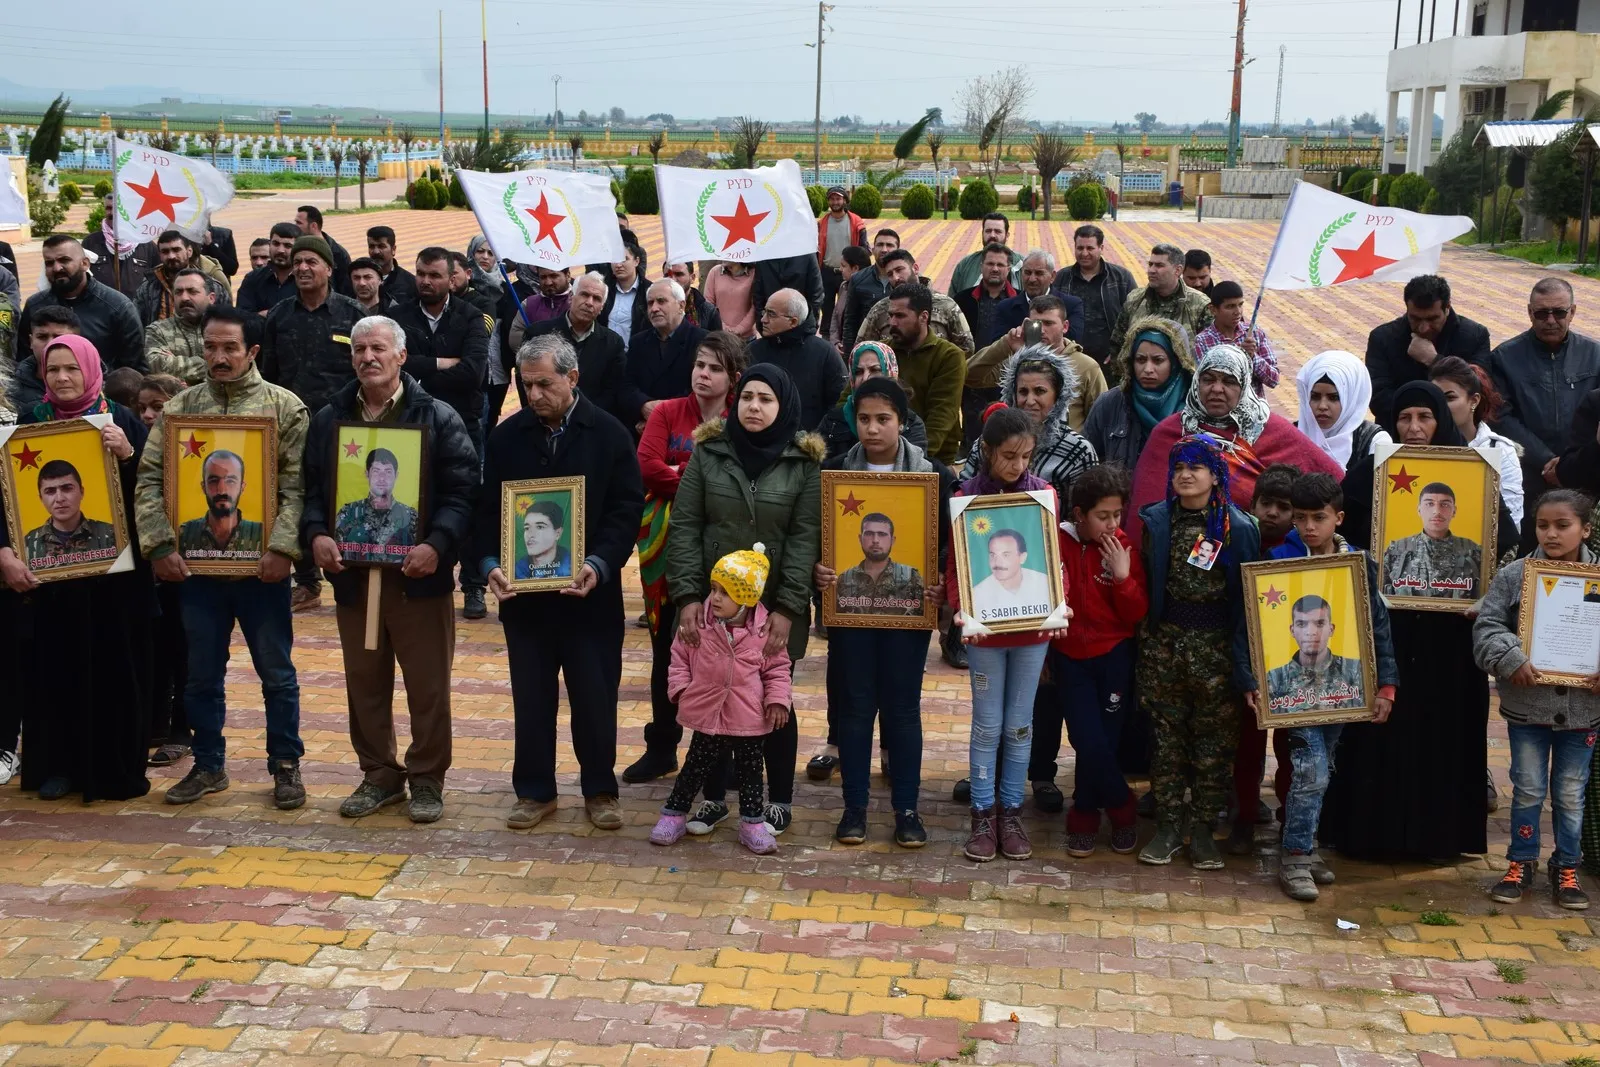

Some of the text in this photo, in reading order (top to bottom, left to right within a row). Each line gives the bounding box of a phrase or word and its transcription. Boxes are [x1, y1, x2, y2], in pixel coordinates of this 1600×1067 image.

[142, 152, 170, 167] PYD
[727, 178, 753, 190] PYD
[1364, 213, 1395, 226] PYD
[141, 224, 164, 236] 200
[538, 249, 561, 264] 2003
[724, 247, 752, 260] 2003
[1429, 577, 1473, 592] الشهيد
[1021, 603, 1049, 616] BEKIR
[1319, 682, 1360, 705] الشهيد
